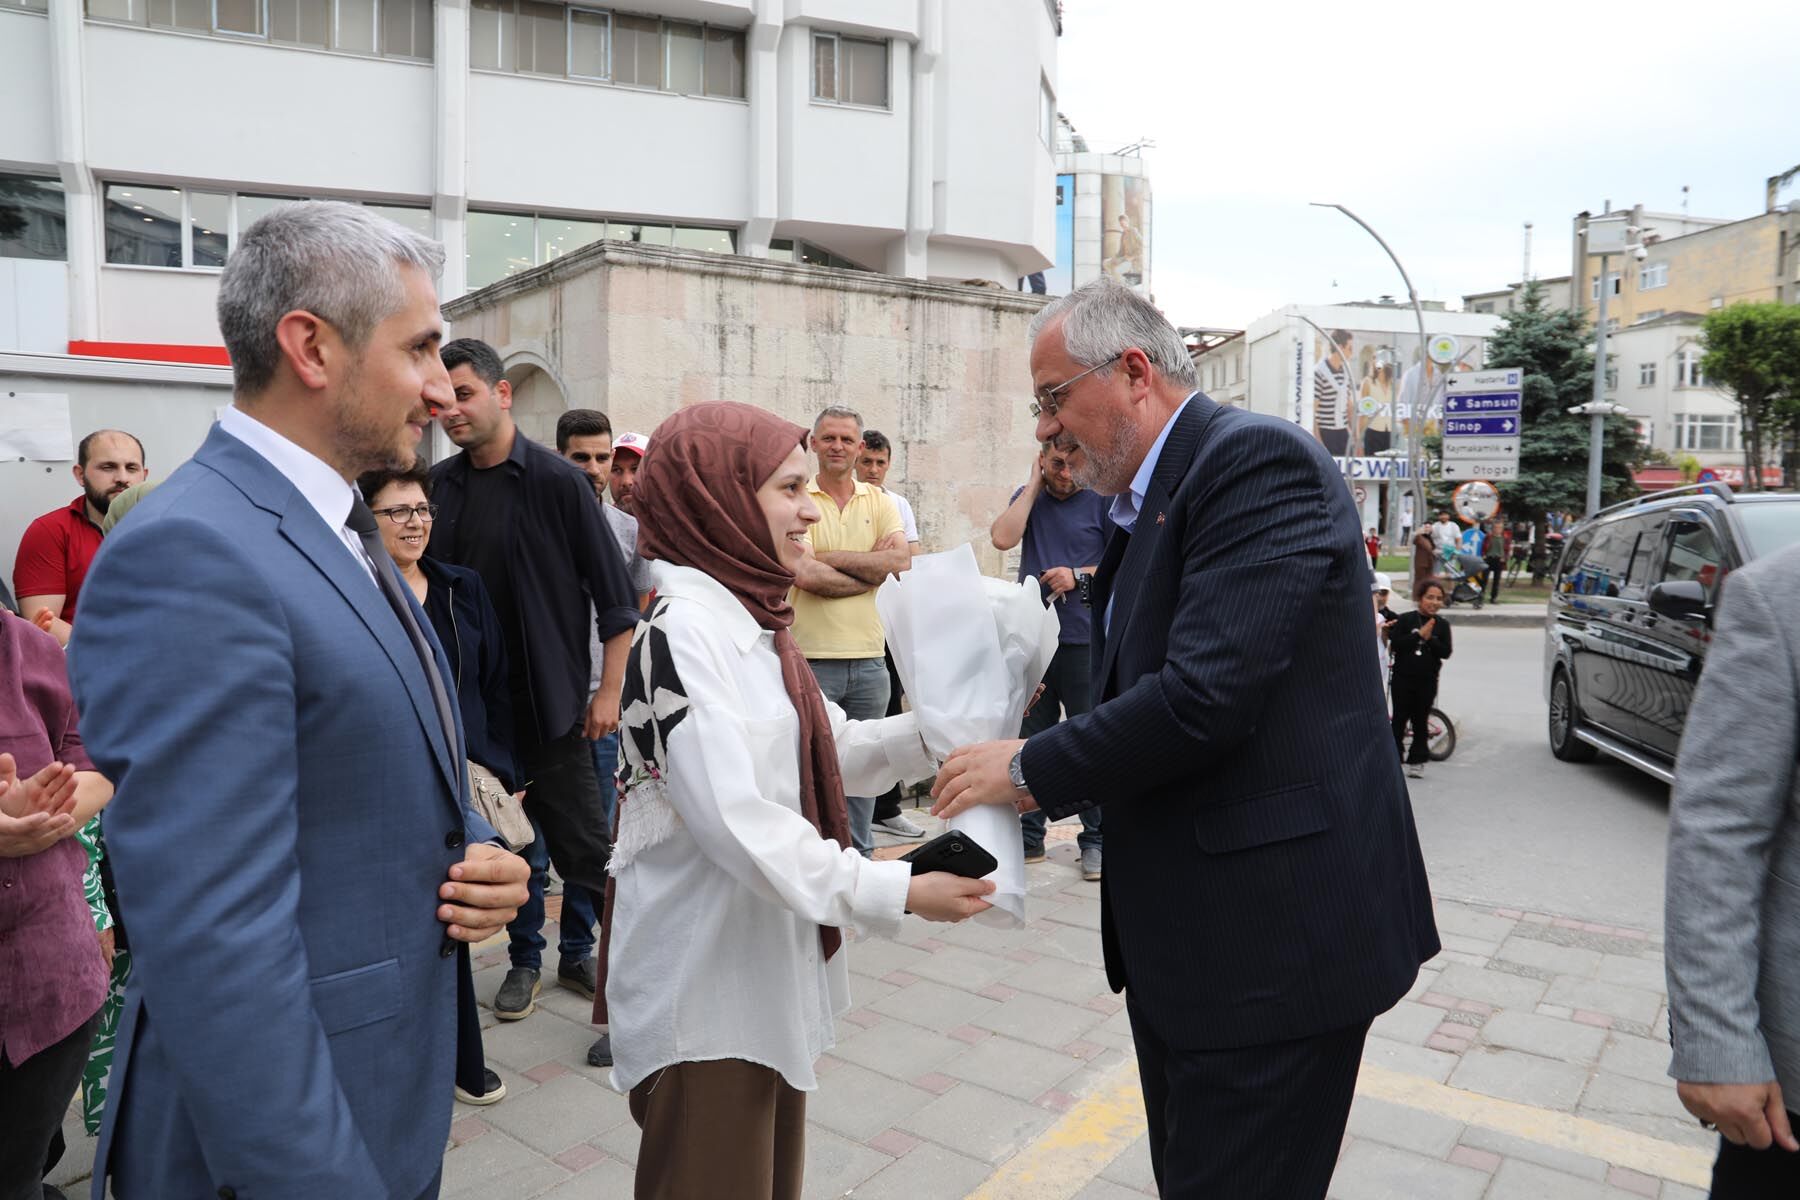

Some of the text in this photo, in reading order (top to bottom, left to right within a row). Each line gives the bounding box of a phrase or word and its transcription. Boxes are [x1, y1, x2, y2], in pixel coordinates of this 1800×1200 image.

[1466, 398, 1518, 408] Samsun
[1447, 421, 1482, 433] Sinop
[1473, 465, 1515, 476] Otogar
